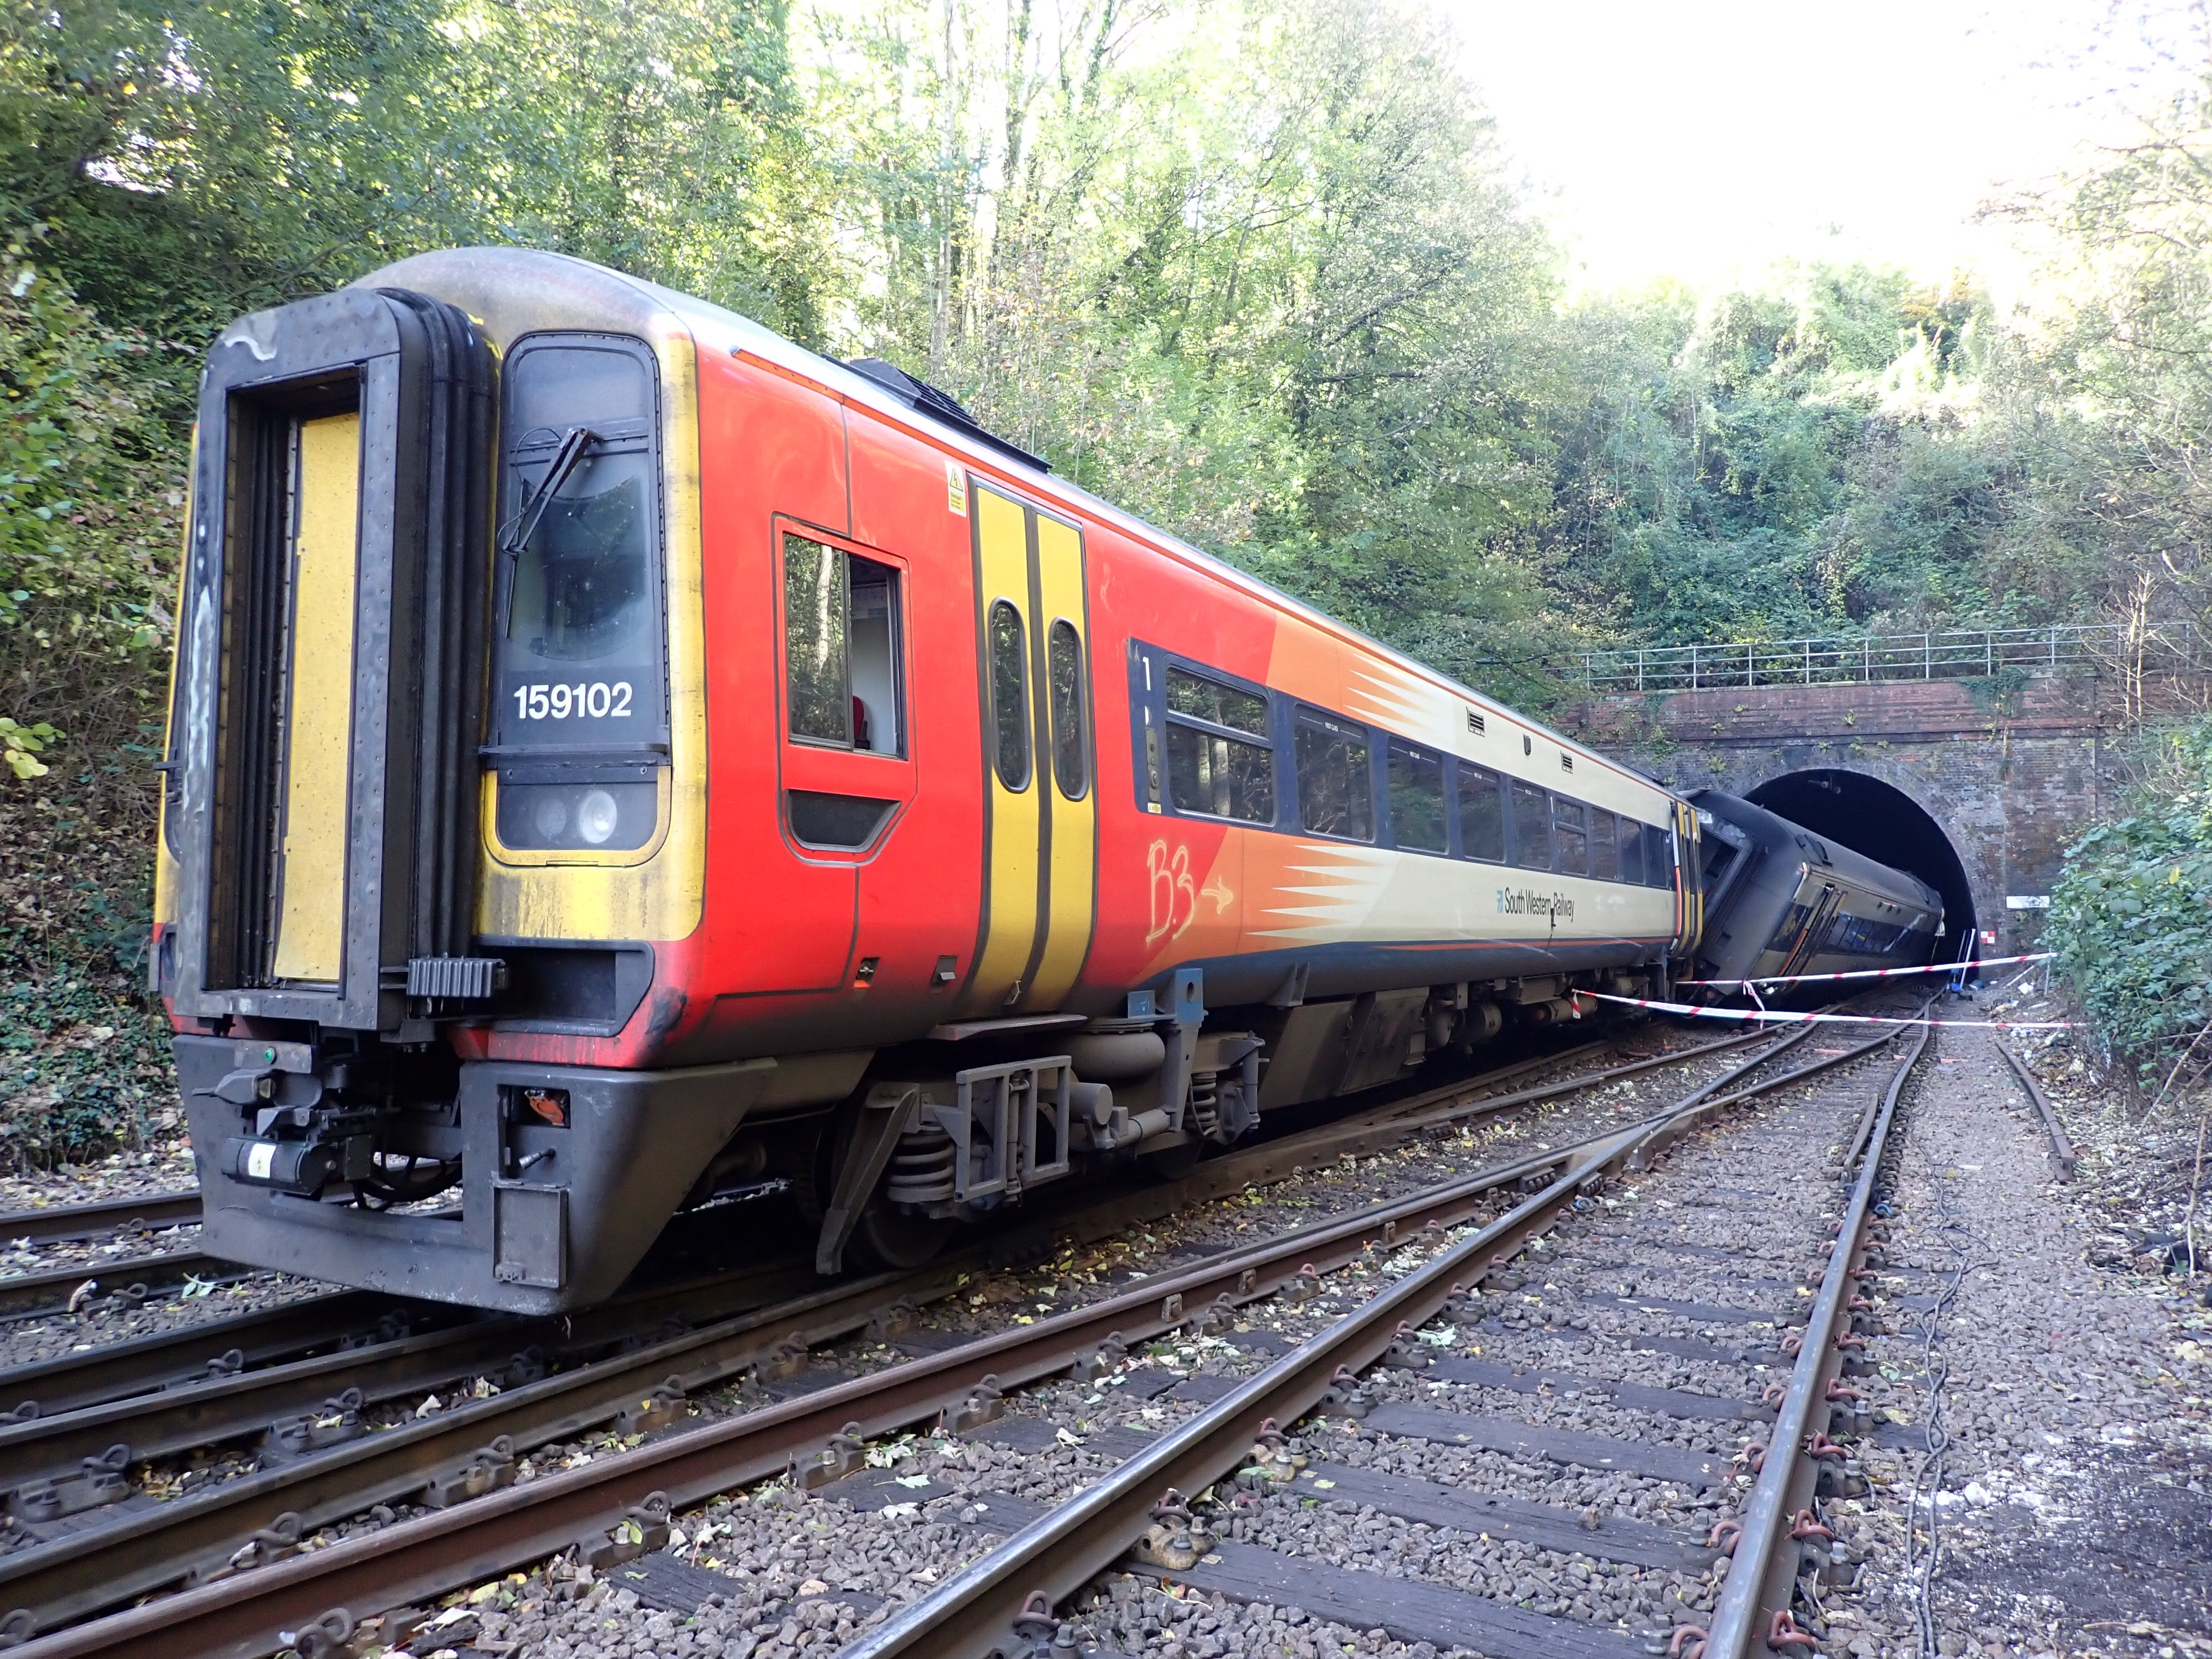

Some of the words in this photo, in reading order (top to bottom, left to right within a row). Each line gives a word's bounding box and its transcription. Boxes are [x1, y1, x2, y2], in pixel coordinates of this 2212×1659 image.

[1142, 656, 1151, 691] 1
[513, 682, 633, 719] 159102
[1505, 886, 1525, 914] South
[1525, 889, 1551, 916] Western
[1553, 891, 1575, 923] Railway
